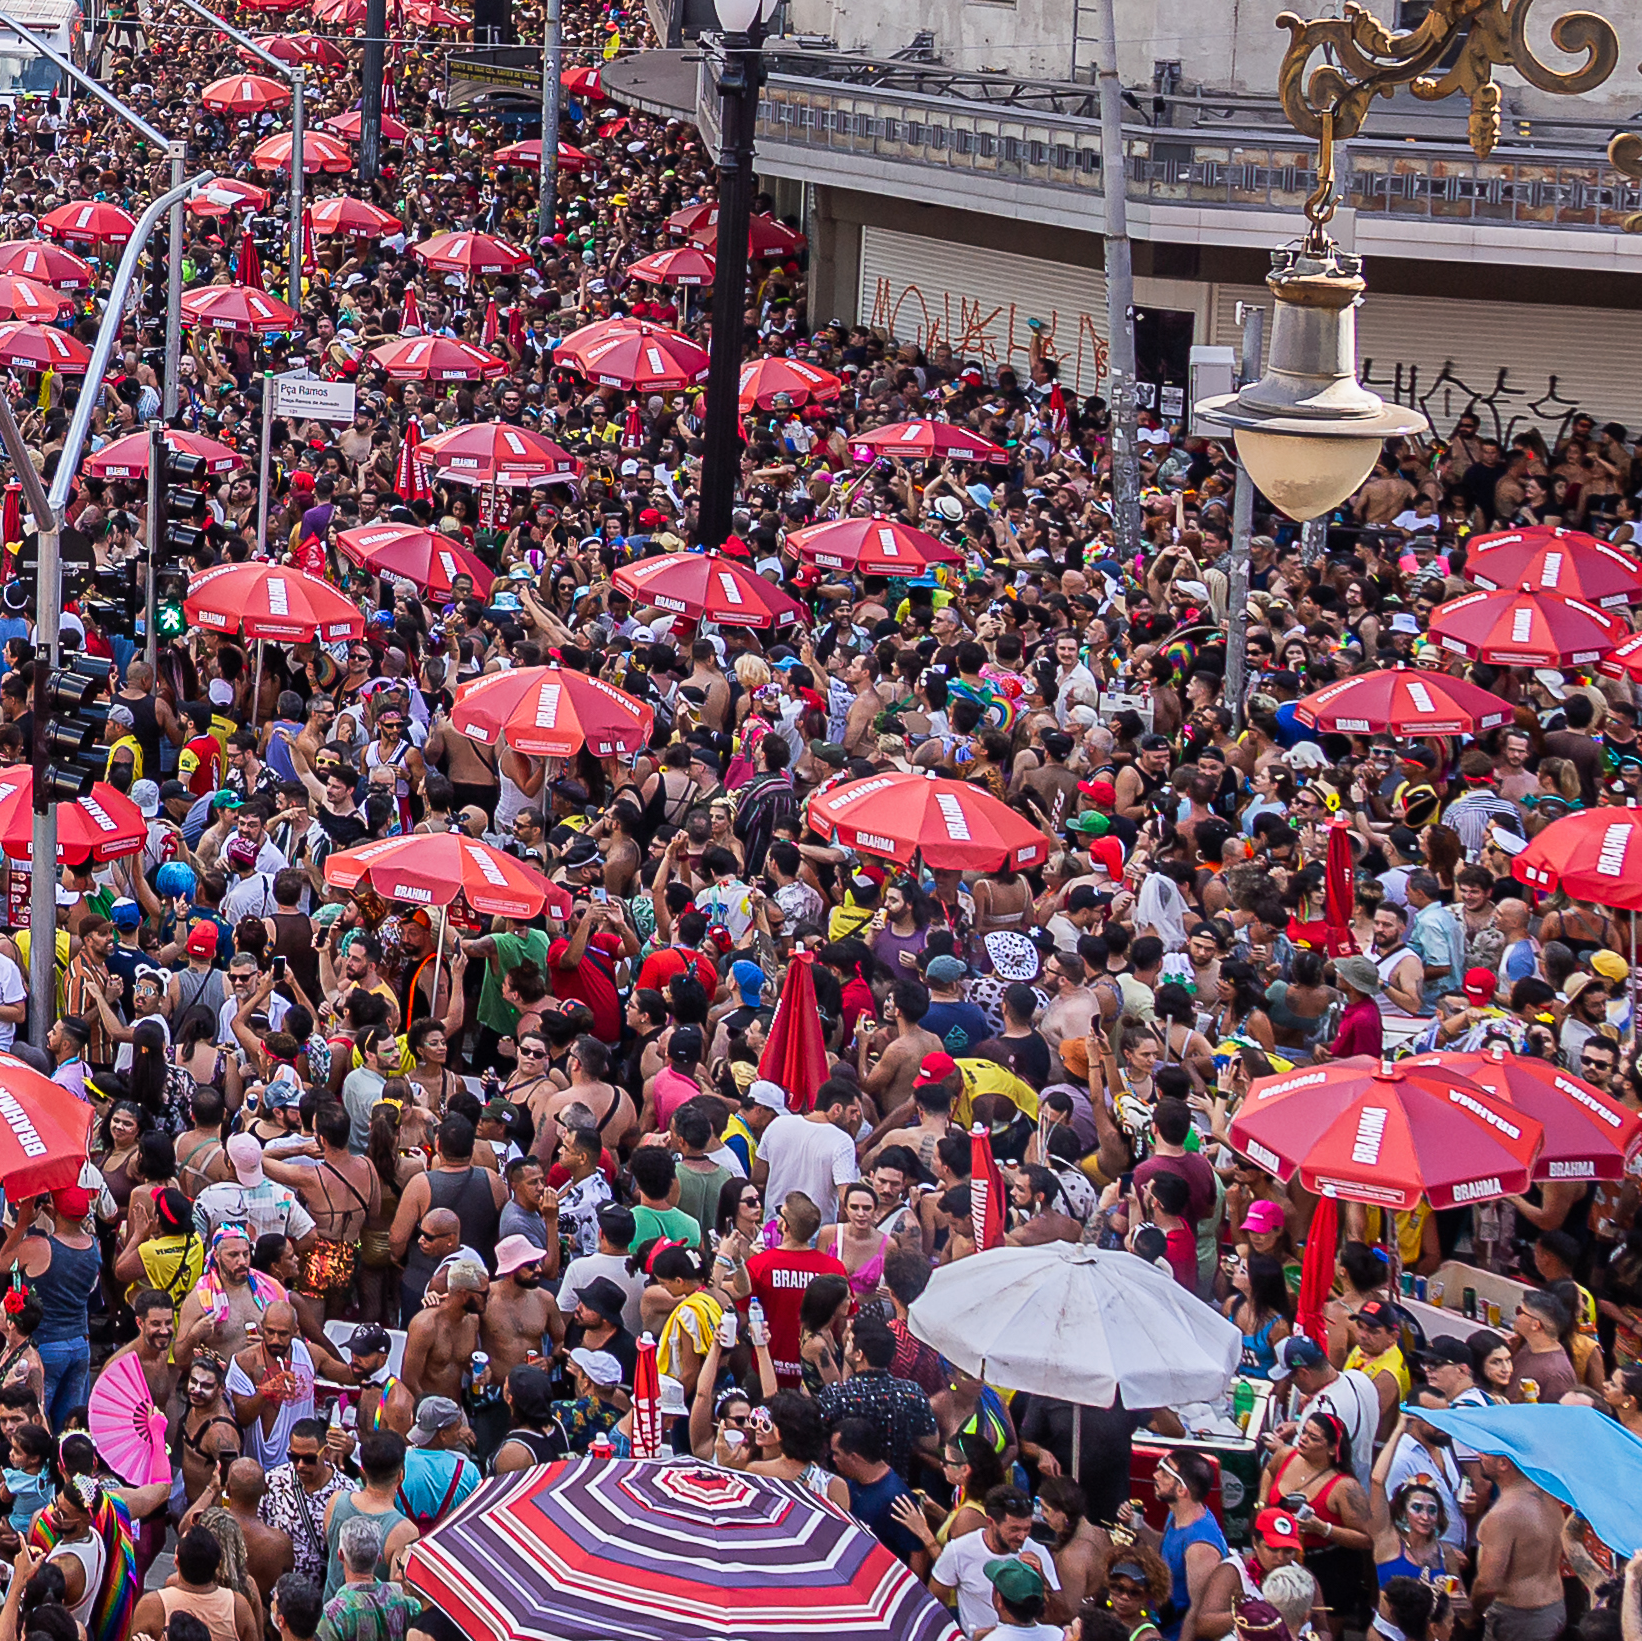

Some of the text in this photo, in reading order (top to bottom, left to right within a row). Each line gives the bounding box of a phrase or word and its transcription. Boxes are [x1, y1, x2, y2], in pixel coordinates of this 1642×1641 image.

[280, 384, 328, 397] Pça Ramos
[535, 683, 561, 728] BRAHMA
[827, 778, 895, 813] BRAHMA
[935, 793, 971, 841] BRAHMA
[856, 831, 895, 853] BRAHMA
[1596, 823, 1633, 876] BRAHMA
[393, 884, 432, 903] BRAHMA
[1257, 1072, 1326, 1100] BRAHMA
[1554, 1076, 1622, 1128] BRAHMA
[1448, 1089, 1522, 1139] BRAHMA
[1351, 1106, 1388, 1165] BRAHMA
[1549, 1160, 1595, 1178] BRAHMA
[1452, 1177, 1503, 1202] BRAHMA
